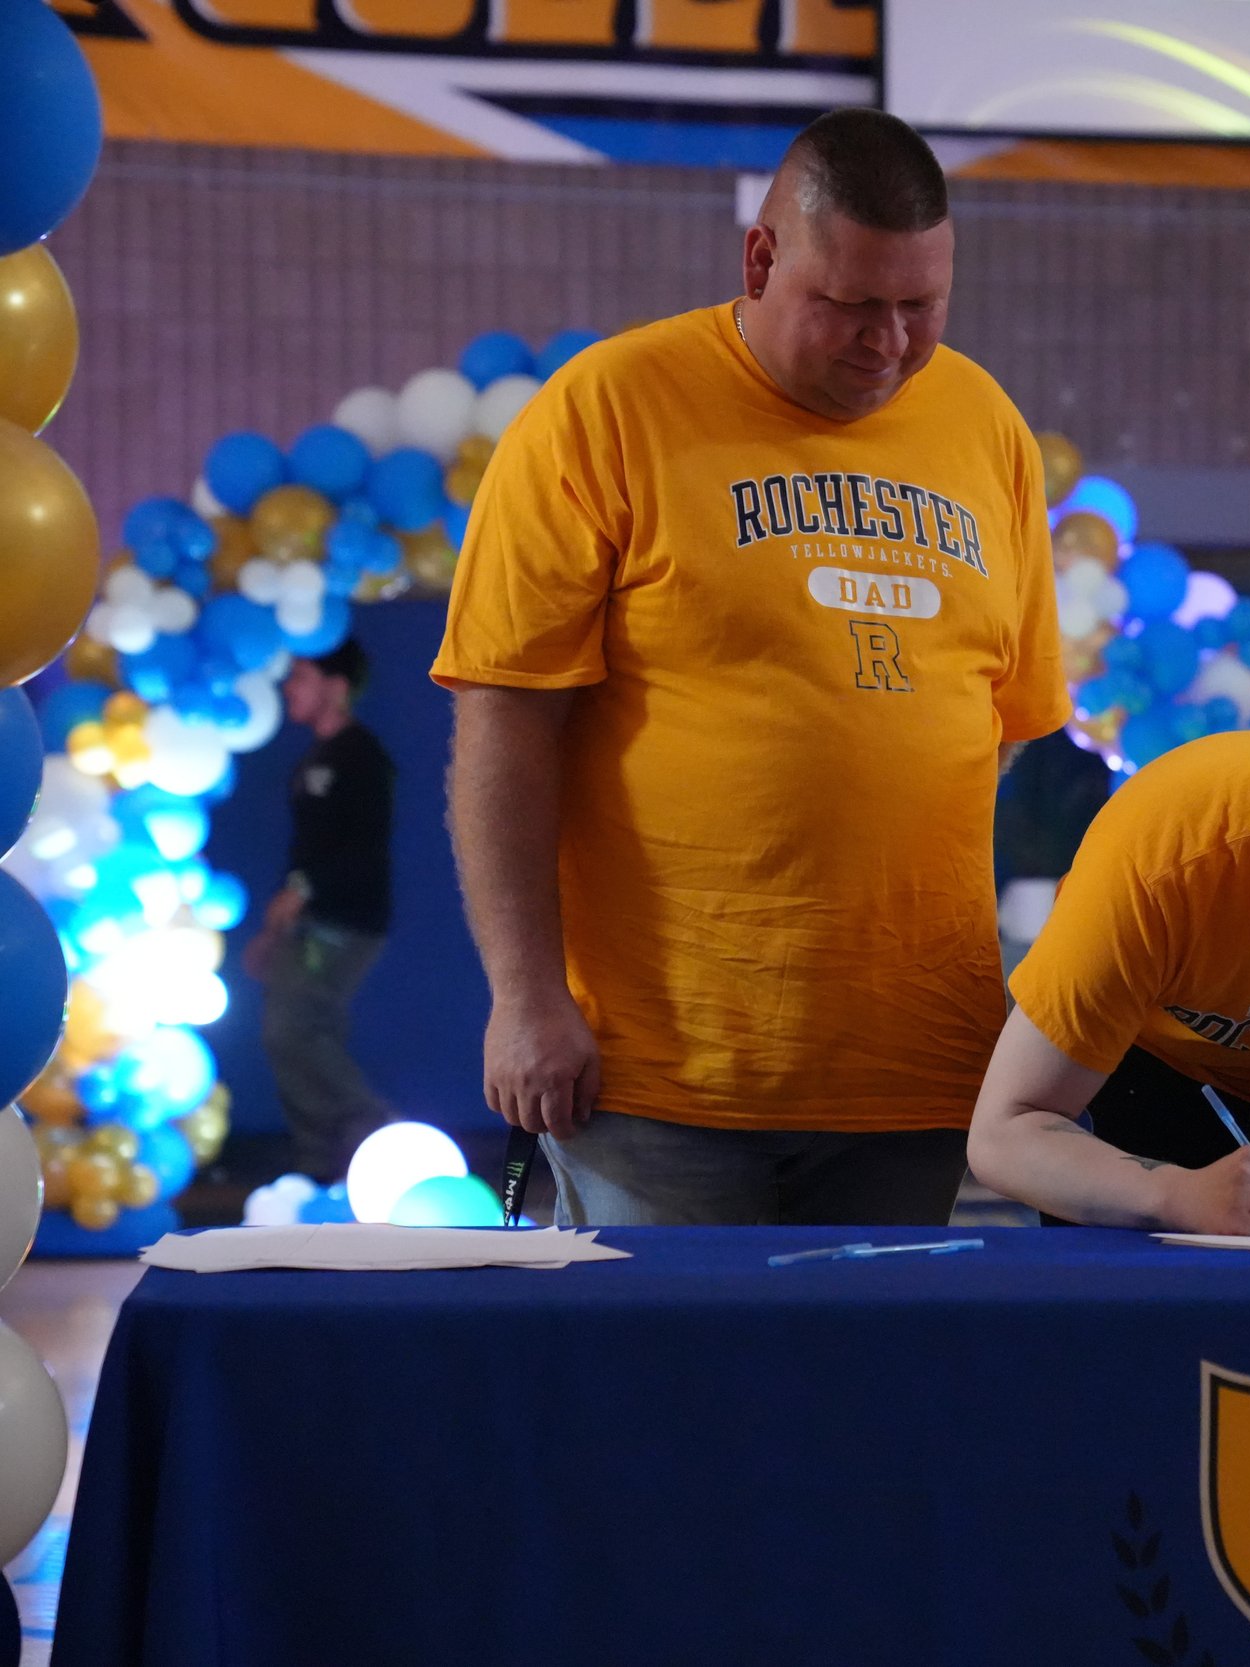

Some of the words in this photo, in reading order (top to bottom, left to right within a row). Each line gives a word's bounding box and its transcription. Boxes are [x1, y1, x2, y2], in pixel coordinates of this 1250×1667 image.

[730, 472, 989, 579] ROCHESTER
[790, 544, 950, 578] YELLOWJACKETS
[838, 576, 912, 610] DAD
[849, 619, 911, 692] R
